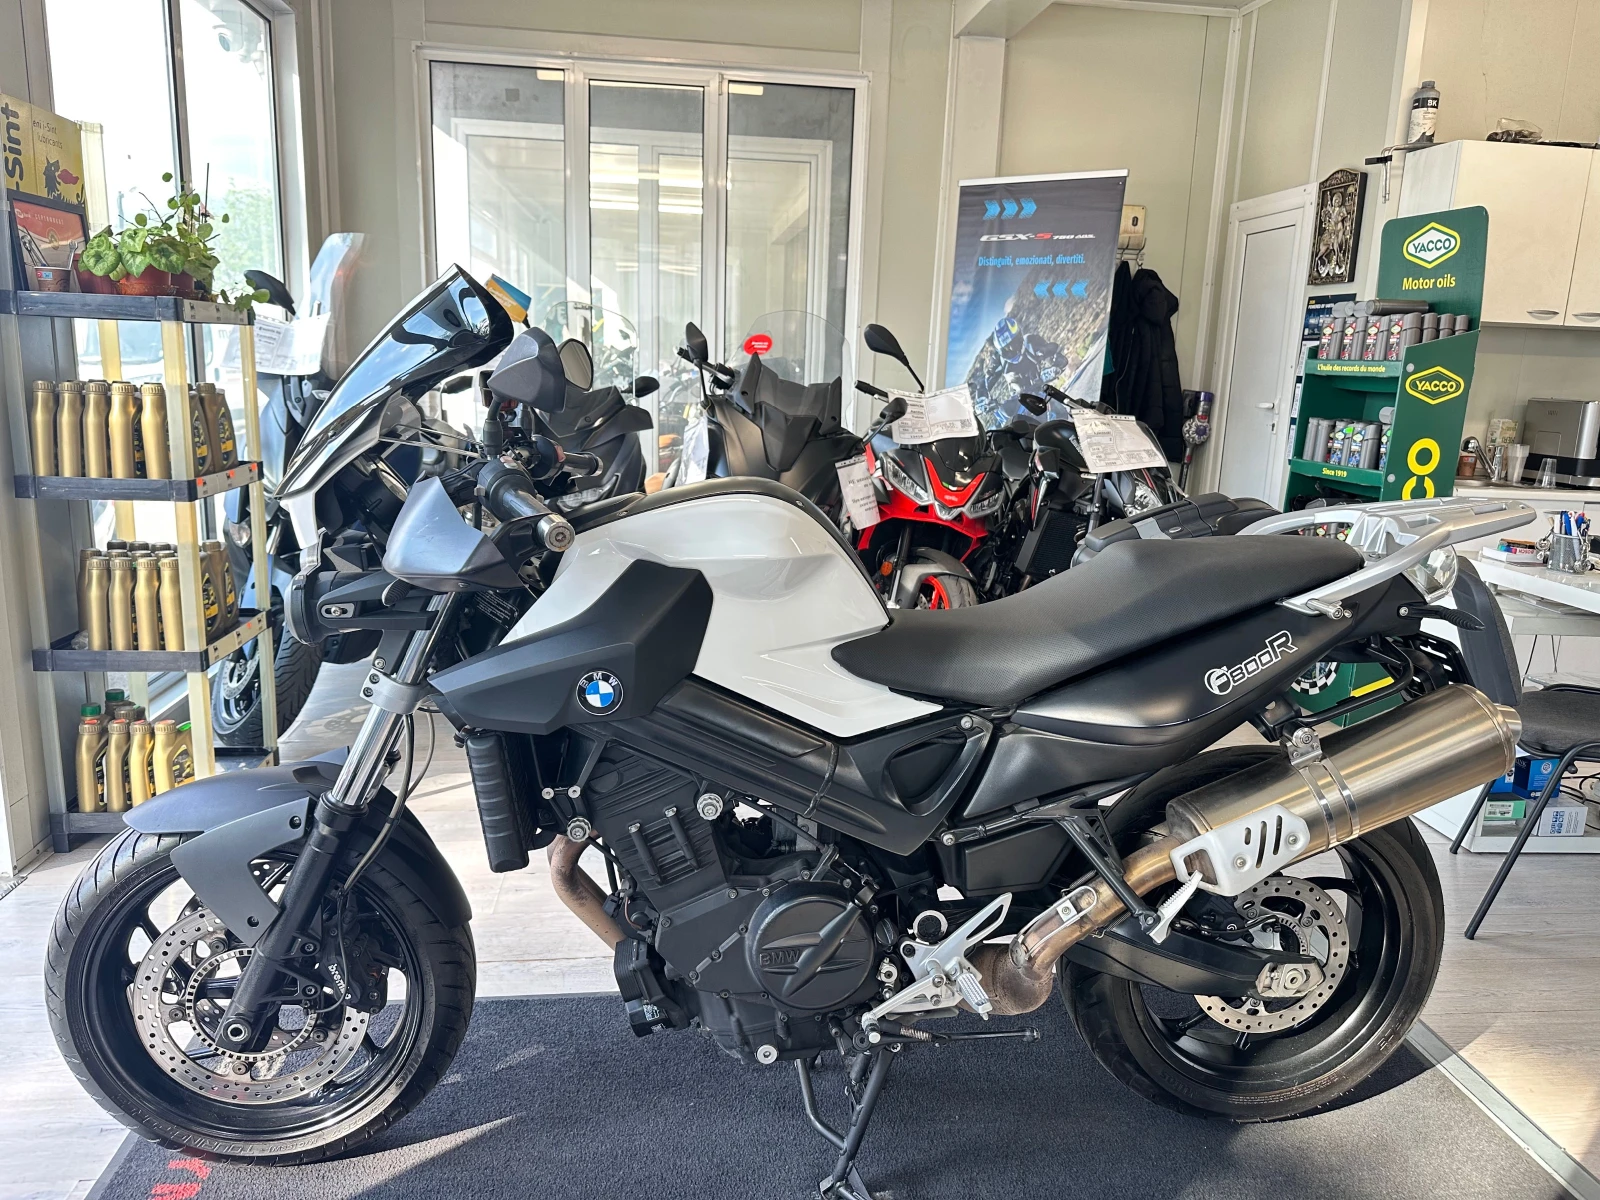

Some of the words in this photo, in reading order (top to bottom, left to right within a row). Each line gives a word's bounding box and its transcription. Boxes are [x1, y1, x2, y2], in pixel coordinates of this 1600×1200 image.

[37, 132, 63, 150] lubricants
[980, 232, 1053, 242] GSX-S
[1412, 237, 1452, 254] YACCO
[978, 255, 1014, 268] Distinguiti,
[1015, 254, 1054, 266] emozionati,
[1056, 254, 1086, 264] divertiti.
[1402, 276, 1435, 290] Motor
[1437, 274, 1456, 288] oils
[1416, 380, 1456, 392] YACCO
[1322, 467, 1335, 476] Since
[1335, 468, 1347, 477] 1919
[1204, 630, 1298, 695] F800R
[580, 672, 618, 688] BMW
[760, 950, 799, 967] BMW
